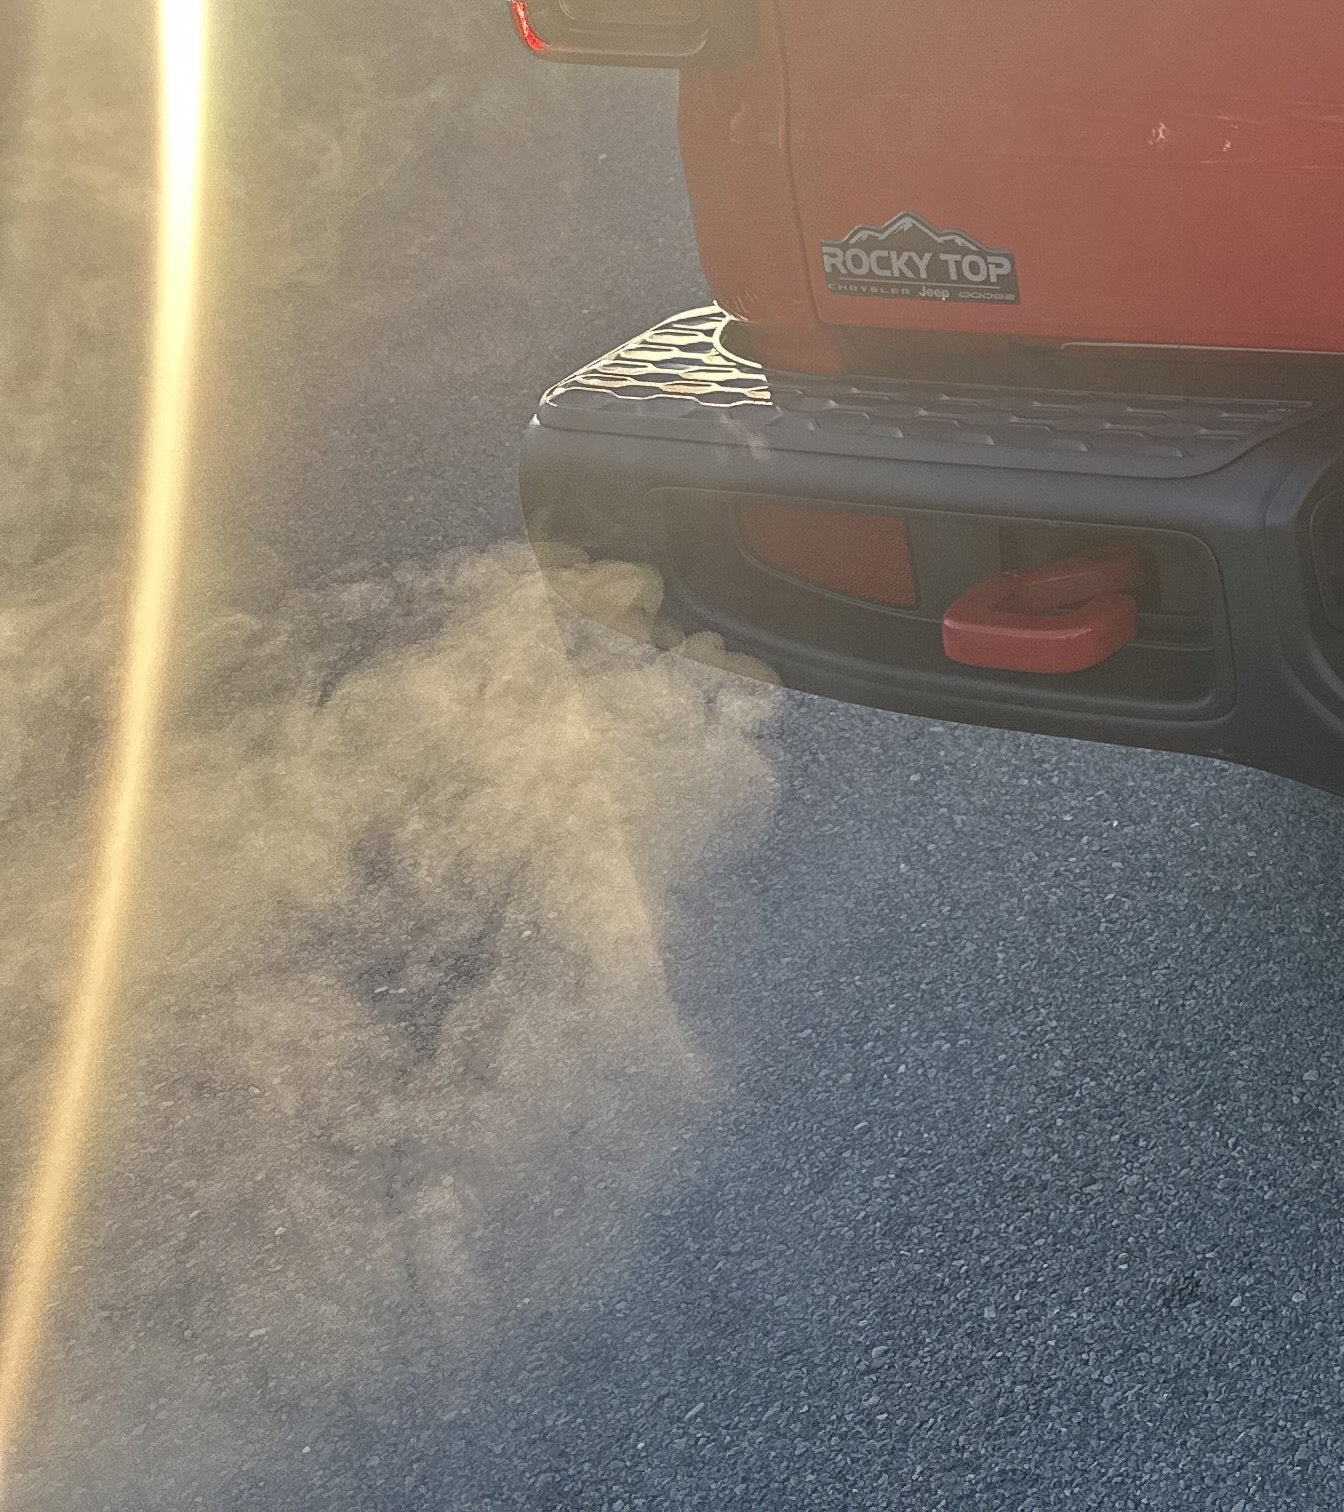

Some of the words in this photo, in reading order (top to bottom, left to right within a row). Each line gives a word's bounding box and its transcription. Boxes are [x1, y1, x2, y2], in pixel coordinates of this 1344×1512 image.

[822, 246, 933, 278] ROCKY
[939, 253, 1012, 282] TOP
[828, 283, 911, 295] CHRYSLER
[918, 285, 950, 301] Jeep
[958, 290, 1016, 301] DODGE
